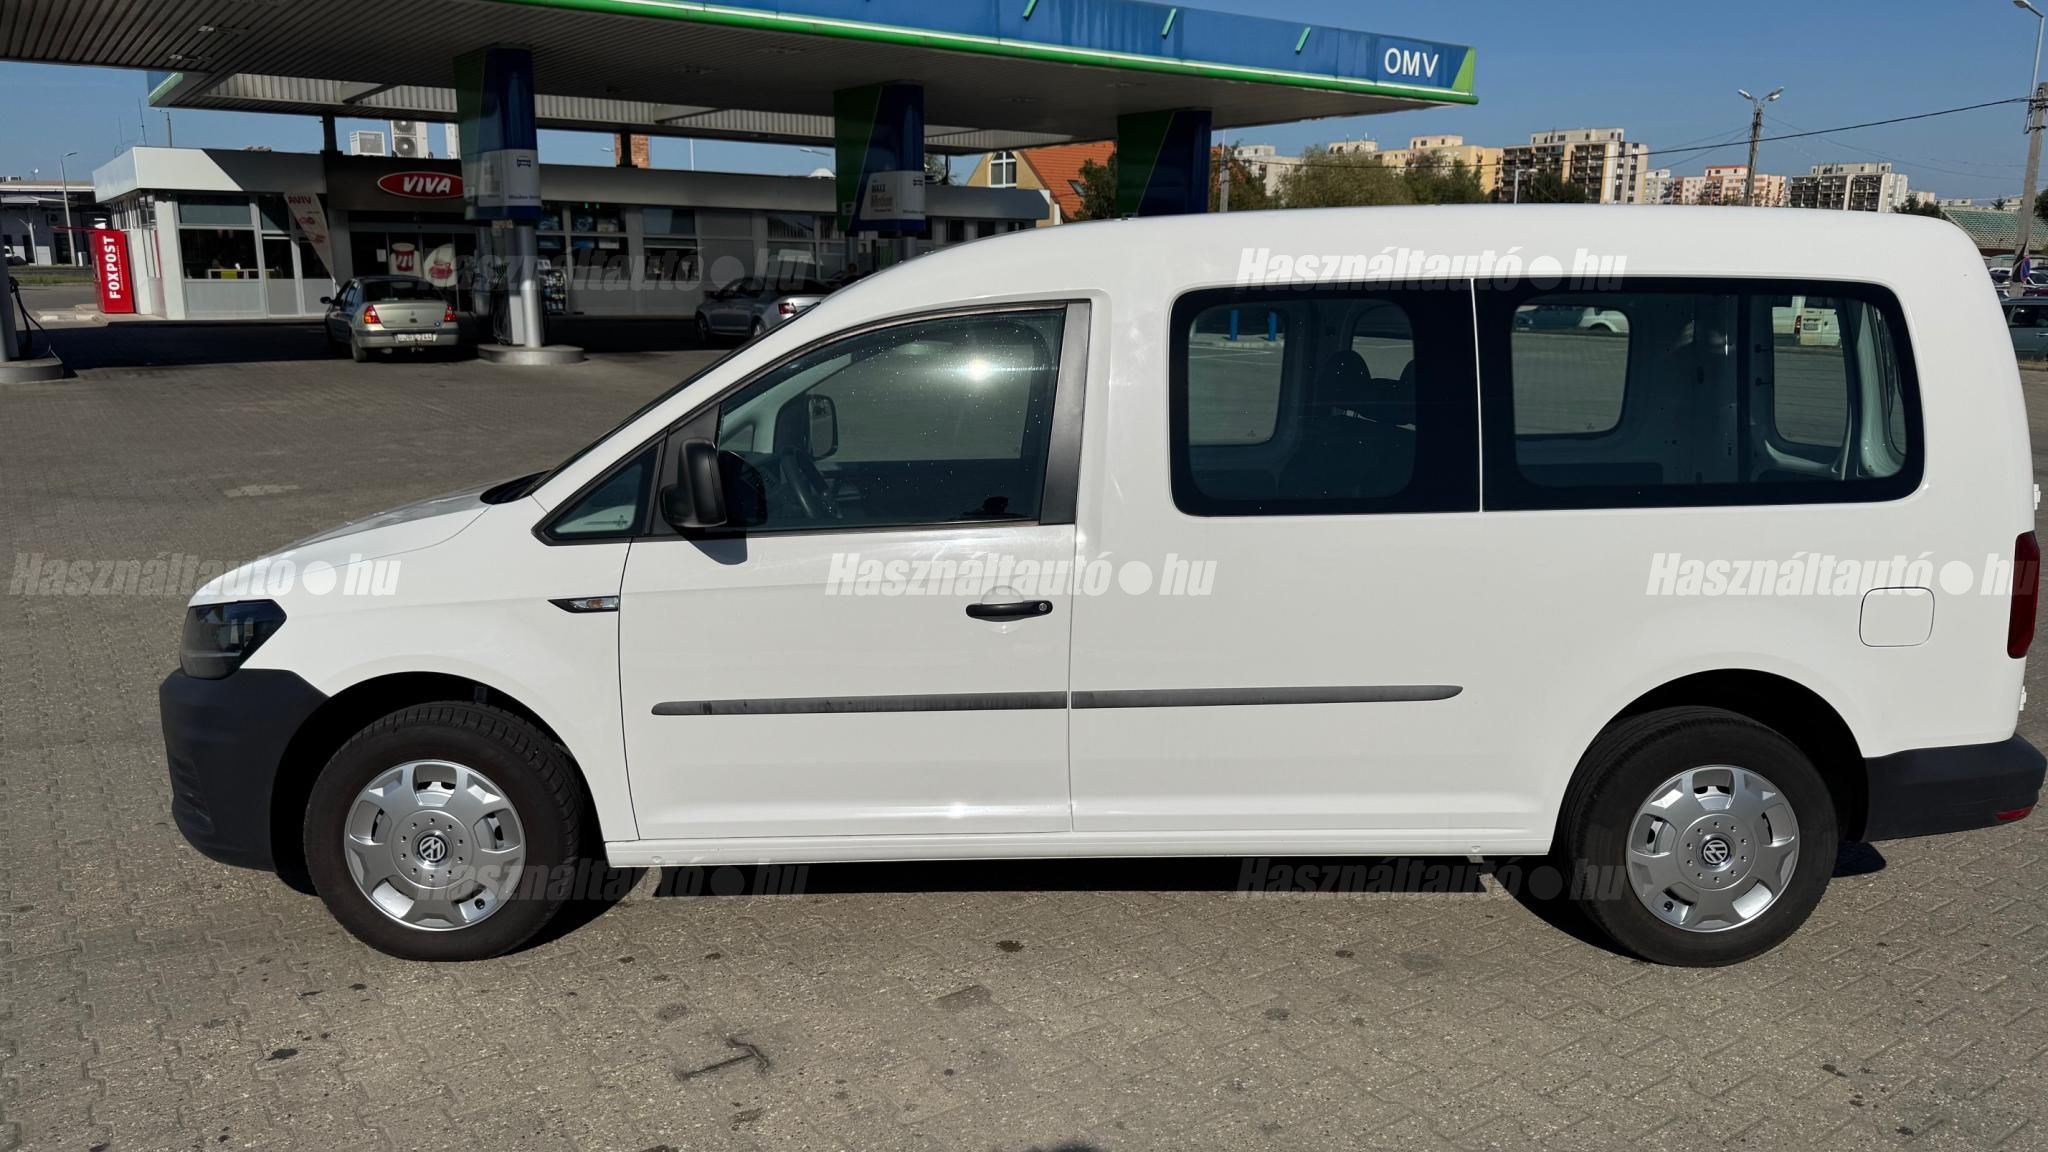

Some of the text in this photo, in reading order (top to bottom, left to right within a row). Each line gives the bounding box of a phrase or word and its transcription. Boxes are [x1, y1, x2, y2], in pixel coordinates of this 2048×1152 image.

[1384, 47, 1439, 78] OMV
[402, 175, 451, 194] VIVA
[102, 235, 121, 299] FOXPOST
